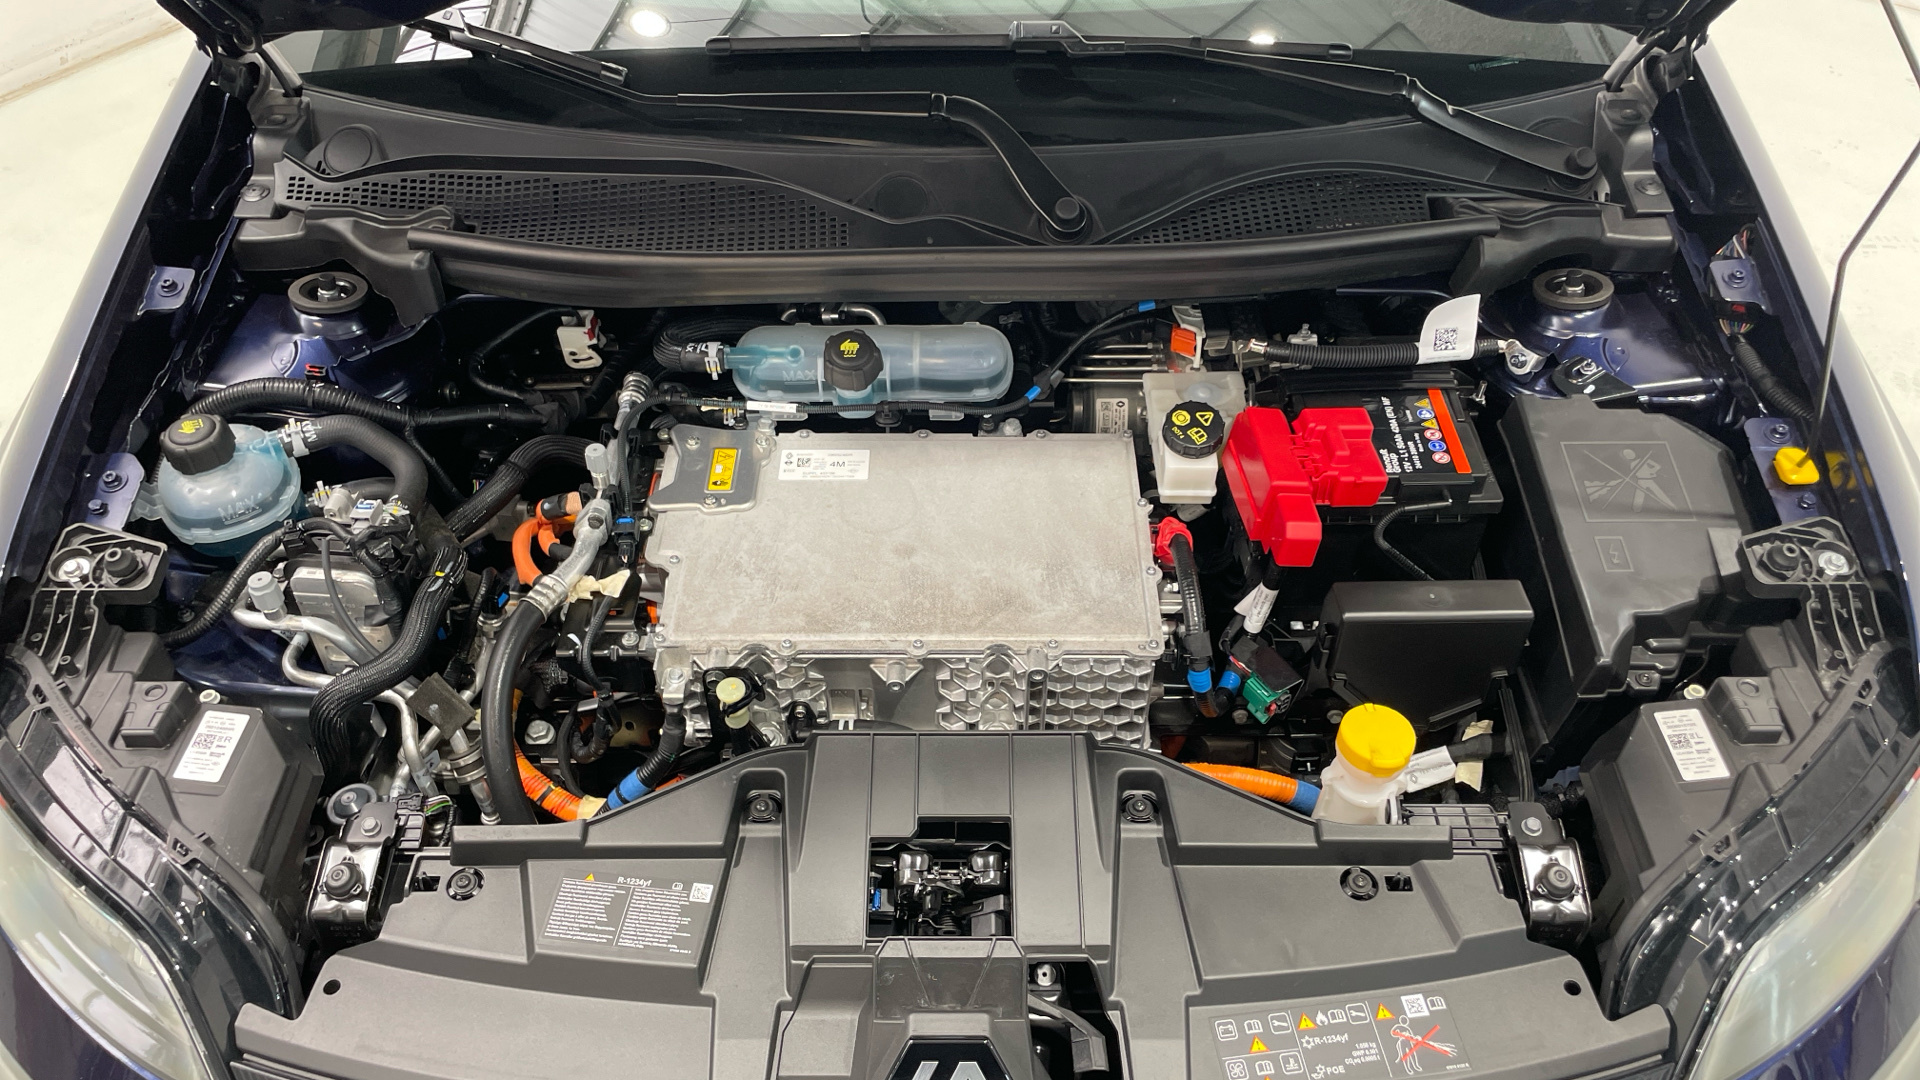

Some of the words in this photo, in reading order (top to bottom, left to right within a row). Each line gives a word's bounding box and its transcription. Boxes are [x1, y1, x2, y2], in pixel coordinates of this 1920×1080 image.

[782, 370, 816, 381] MAX
[218, 495, 260, 522] MAX
[617, 876, 652, 887] R-1234yf
[1314, 1032, 1349, 1045] R-1234yf
[1326, 1065, 1346, 1075] POE
